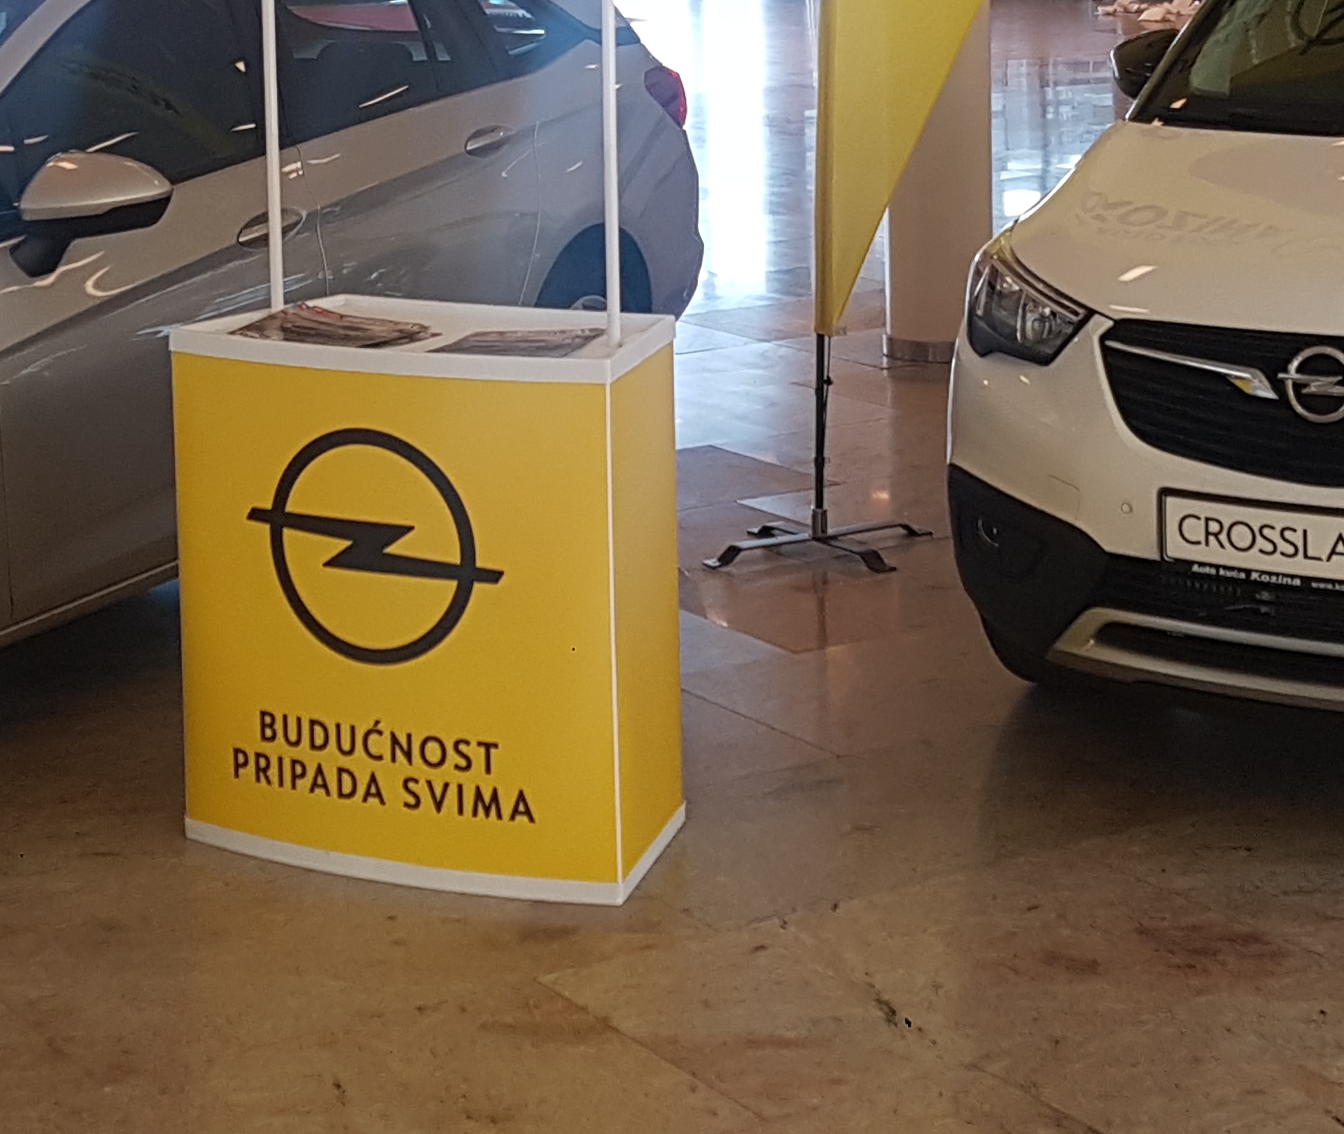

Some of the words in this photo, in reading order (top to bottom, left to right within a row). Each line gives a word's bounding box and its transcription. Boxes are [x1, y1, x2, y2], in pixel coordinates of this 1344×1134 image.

[1250, 571, 1302, 587] Kozina
[259, 709, 499, 776] BUDUĆNOST
[232, 747, 386, 807] PRIPADA
[402, 776, 536, 824] SVIMA
